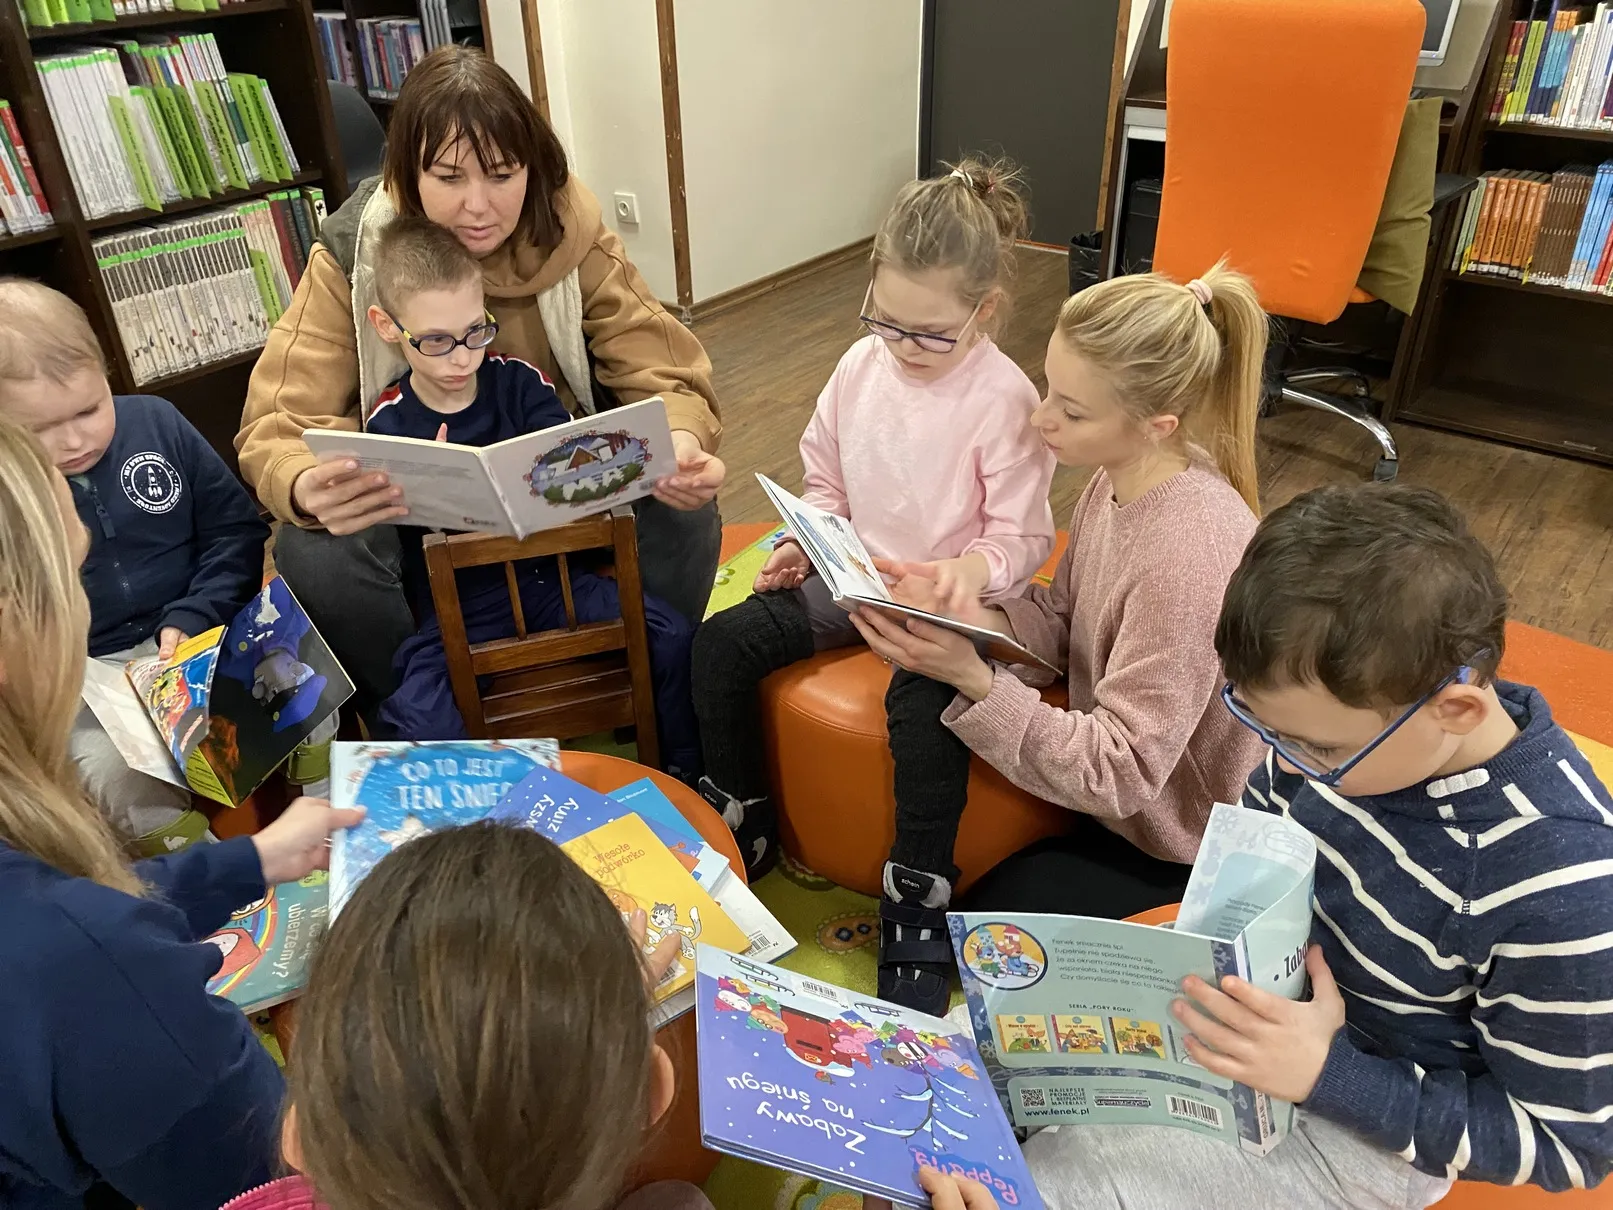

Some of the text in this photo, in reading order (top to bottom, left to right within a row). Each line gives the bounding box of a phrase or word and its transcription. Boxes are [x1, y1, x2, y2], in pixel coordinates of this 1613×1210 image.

[400, 758, 504, 782] CO TO JEST
[396, 784, 444, 810] TEN
[524, 794, 555, 828] wszy
[547, 797, 580, 833] zimy
[593, 842, 631, 865] Wesołe
[595, 849, 646, 879] podwórko
[272, 902, 305, 978] ubierzemy?
[1101, 950, 1142, 962] spodziewa
[1140, 964, 1164, 974] niego
[726, 1072, 854, 1120] na śniegu
[1024, 1108, 1090, 1117] www.fenek.pl
[756, 1100, 867, 1156] Zabawy
[948, 1162, 1019, 1206] Peppa
